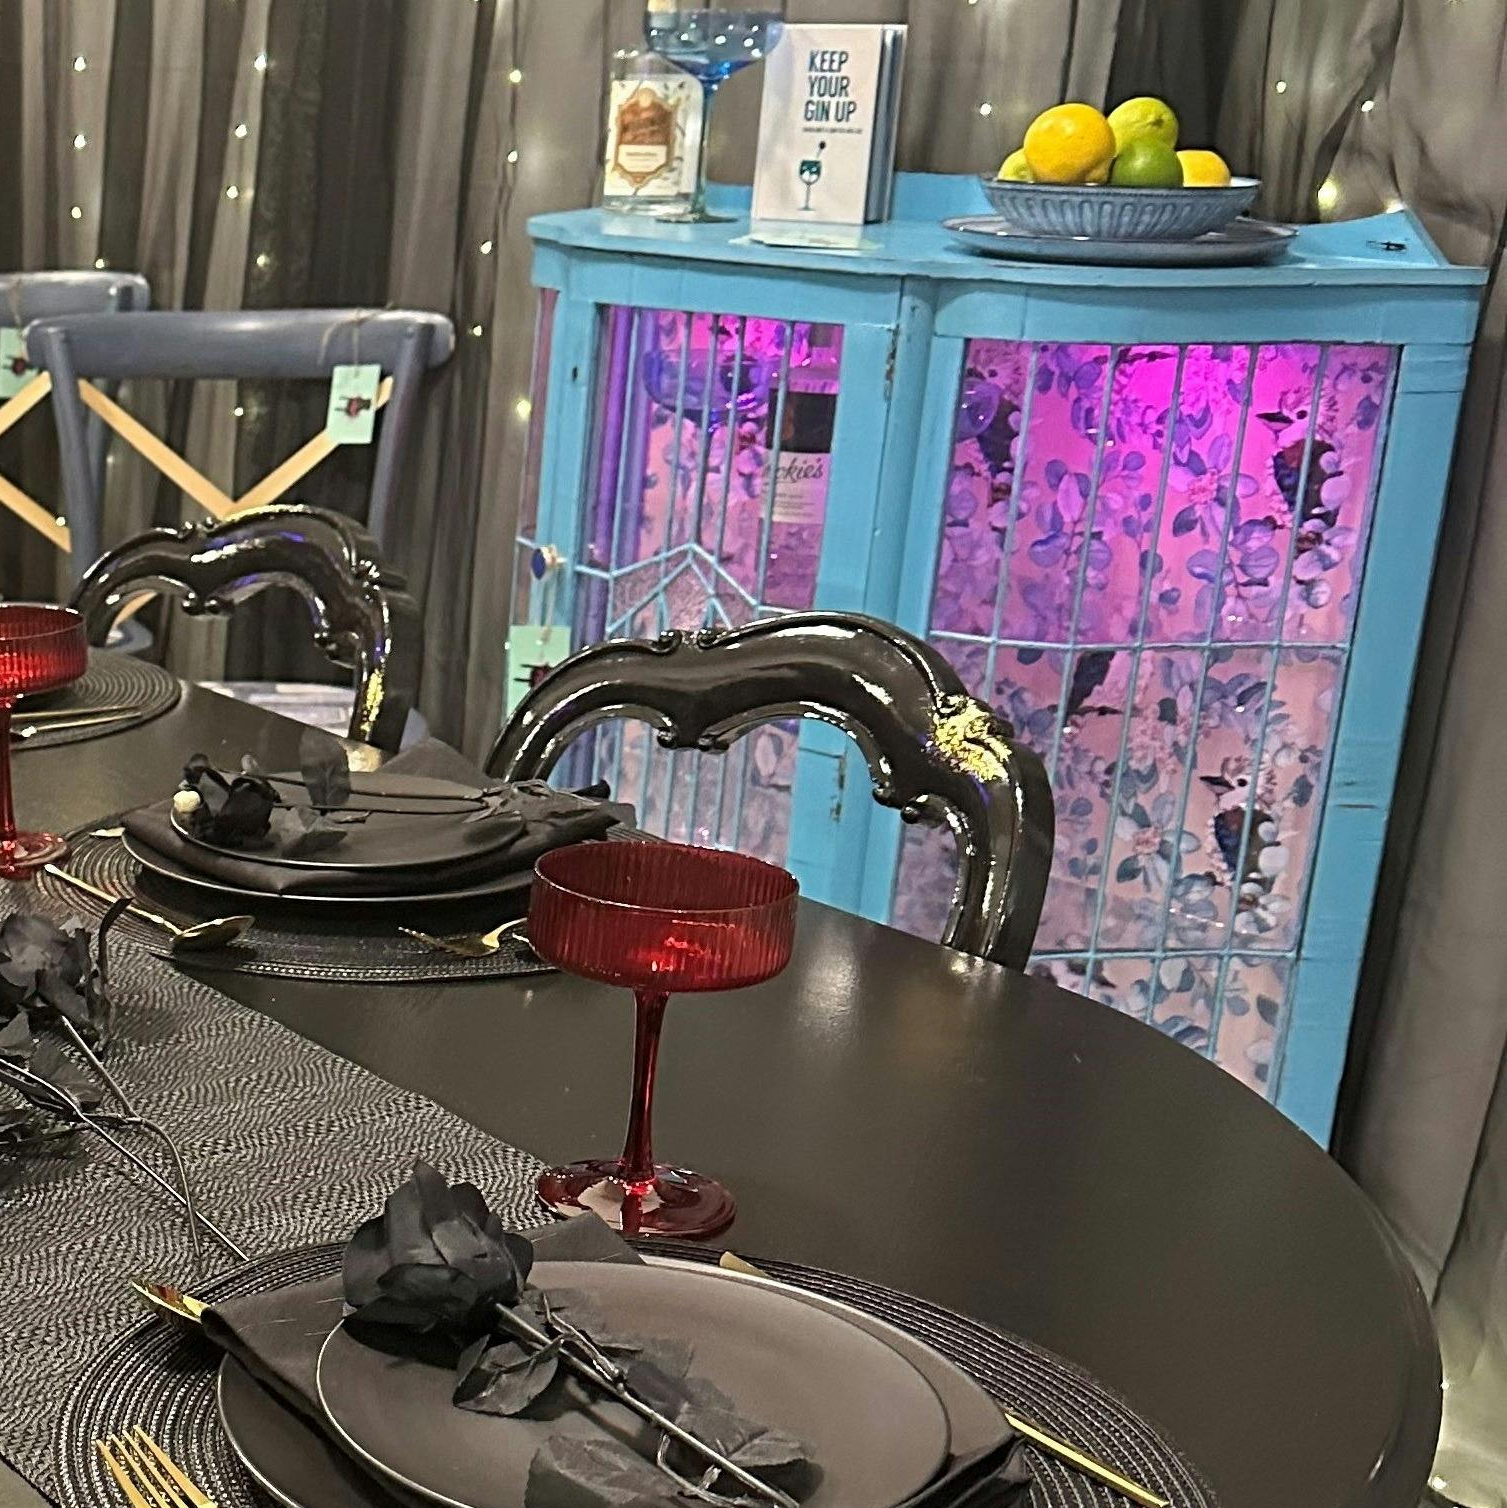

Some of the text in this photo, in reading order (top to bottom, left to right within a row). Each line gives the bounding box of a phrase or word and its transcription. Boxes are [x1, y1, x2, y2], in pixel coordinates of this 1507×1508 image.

[808, 50, 849, 72] KEEP
[808, 75, 850, 97] YOUR
[804, 99, 857, 122] GIN UP
